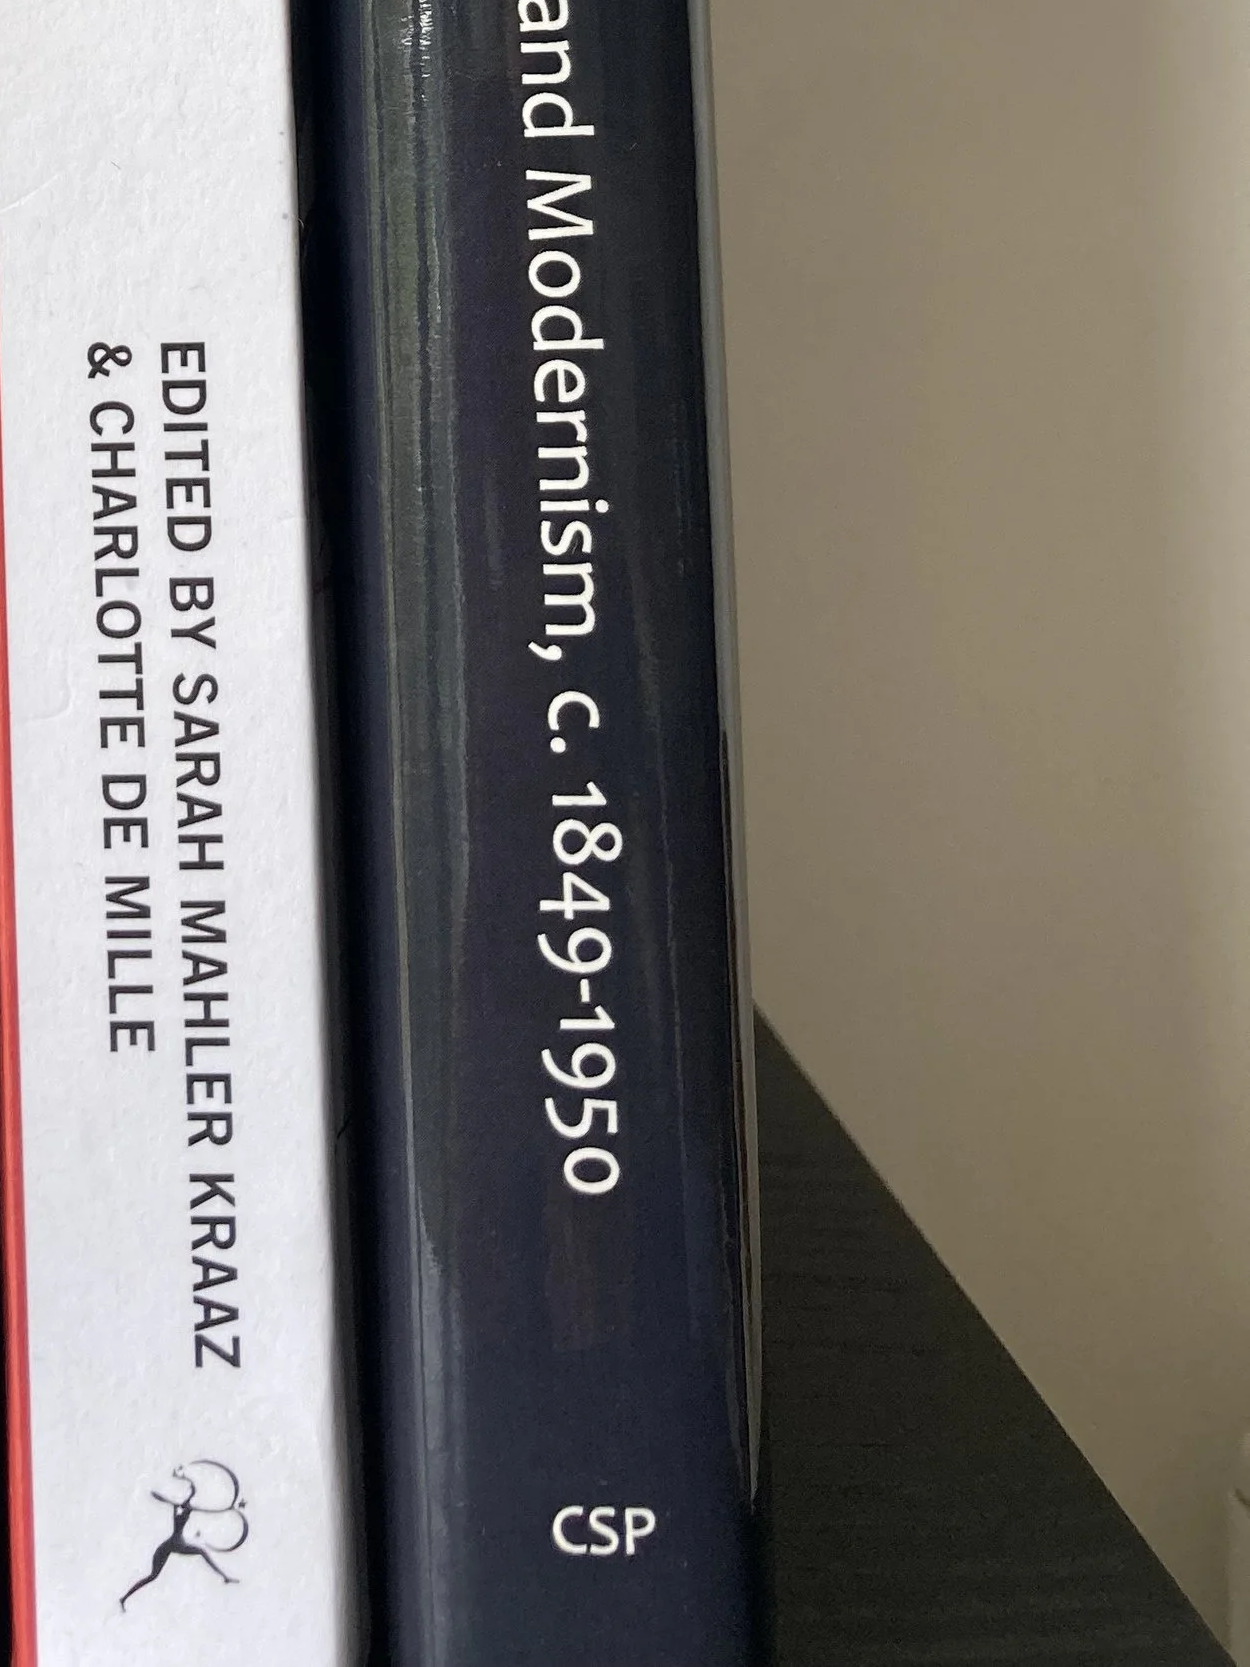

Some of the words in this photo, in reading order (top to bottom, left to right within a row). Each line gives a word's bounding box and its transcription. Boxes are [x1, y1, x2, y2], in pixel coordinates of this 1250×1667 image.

[87, 341, 133, 379] &
[160, 341, 213, 553] EDITED
[525, 169, 610, 661] Modernism,
[89, 400, 146, 749] CHARLOTTE
[168, 576, 217, 650] BY
[101, 774, 149, 850] DE
[172, 672, 225, 871] SARAH
[547, 690, 600, 754] c.
[104, 875, 156, 1053] MILLE
[180, 900, 233, 1147] MAHLER
[537, 781, 623, 1195] 1849-1950
[189, 1173, 241, 1368] KRAAZ
[552, 1505, 656, 1556] CSP
